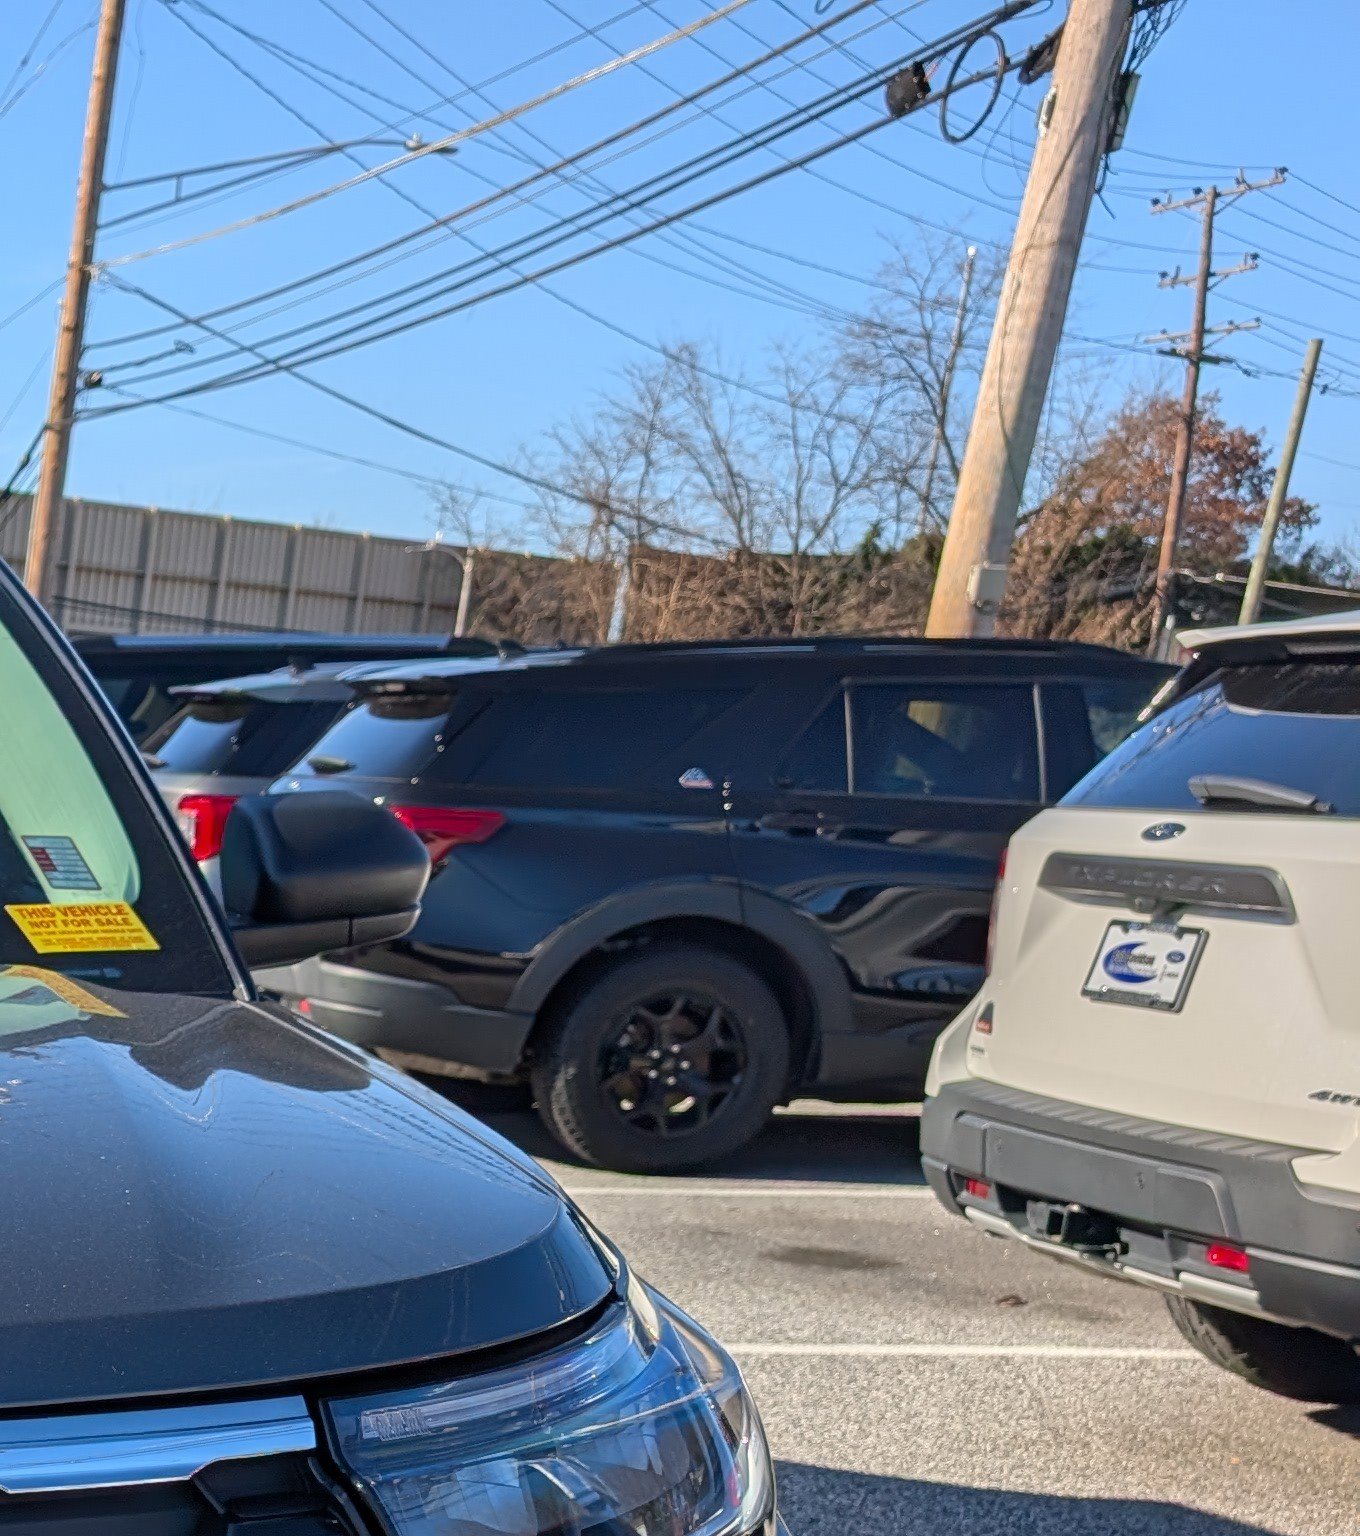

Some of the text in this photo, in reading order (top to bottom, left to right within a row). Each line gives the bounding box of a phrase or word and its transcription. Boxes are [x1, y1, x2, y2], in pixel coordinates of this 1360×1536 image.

[15, 904, 129, 919] THIS VEHICLE
[28, 917, 133, 929] NOT FOR SALE
